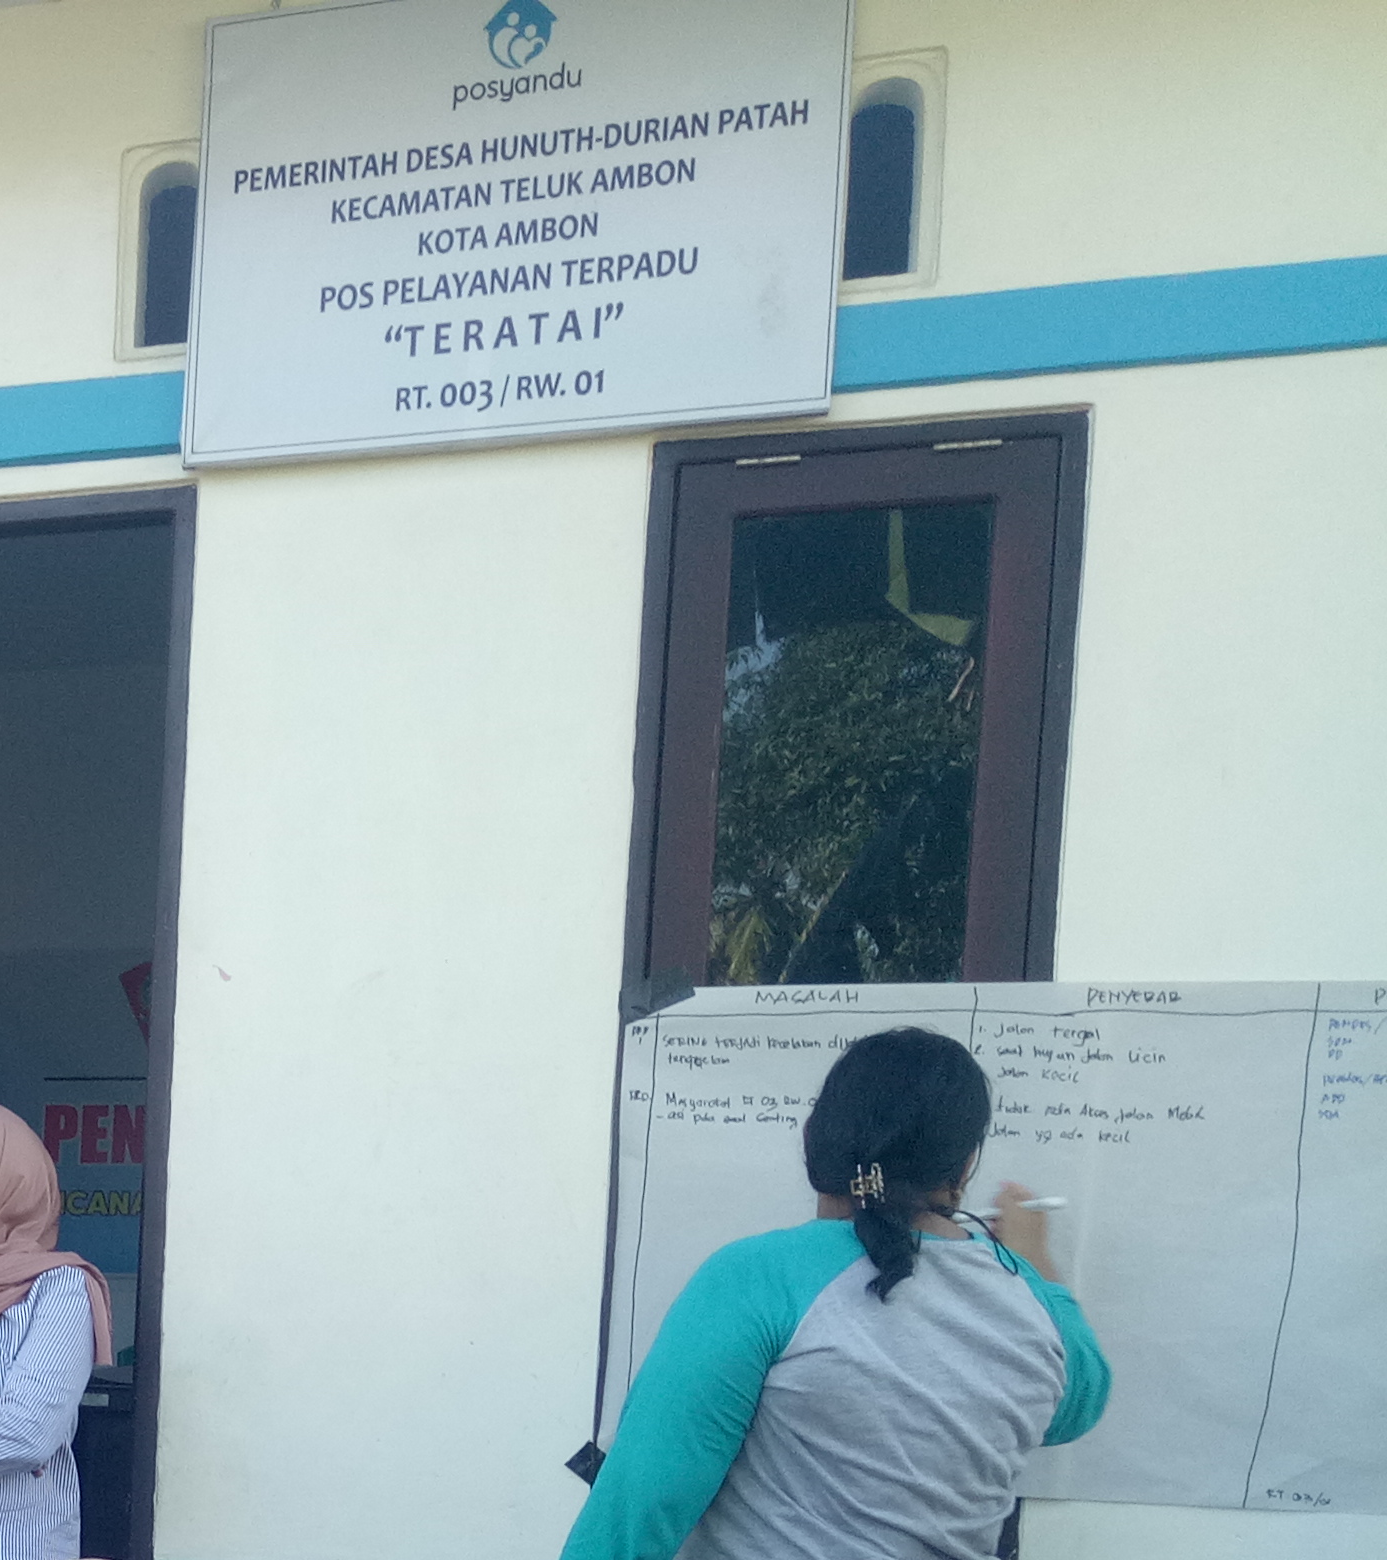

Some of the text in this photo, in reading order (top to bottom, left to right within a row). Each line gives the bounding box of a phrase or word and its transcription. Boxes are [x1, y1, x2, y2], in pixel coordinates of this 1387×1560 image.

[452, 63, 583, 110] posyandu
[234, 151, 398, 194] PEMERINTAH
[406, 143, 473, 173] DESA
[717, 99, 809, 135] PATAH
[331, 158, 696, 224] KECAMATAN TELUK AMBON
[418, 212, 599, 256] KOTA AMBON
[320, 247, 699, 312] POS PELAYANAN TERPADU
[395, 384, 433, 412] RT.
[439, 380, 494, 413] 003
[515, 372, 566, 400] RW.
[574, 369, 606, 396] 01
